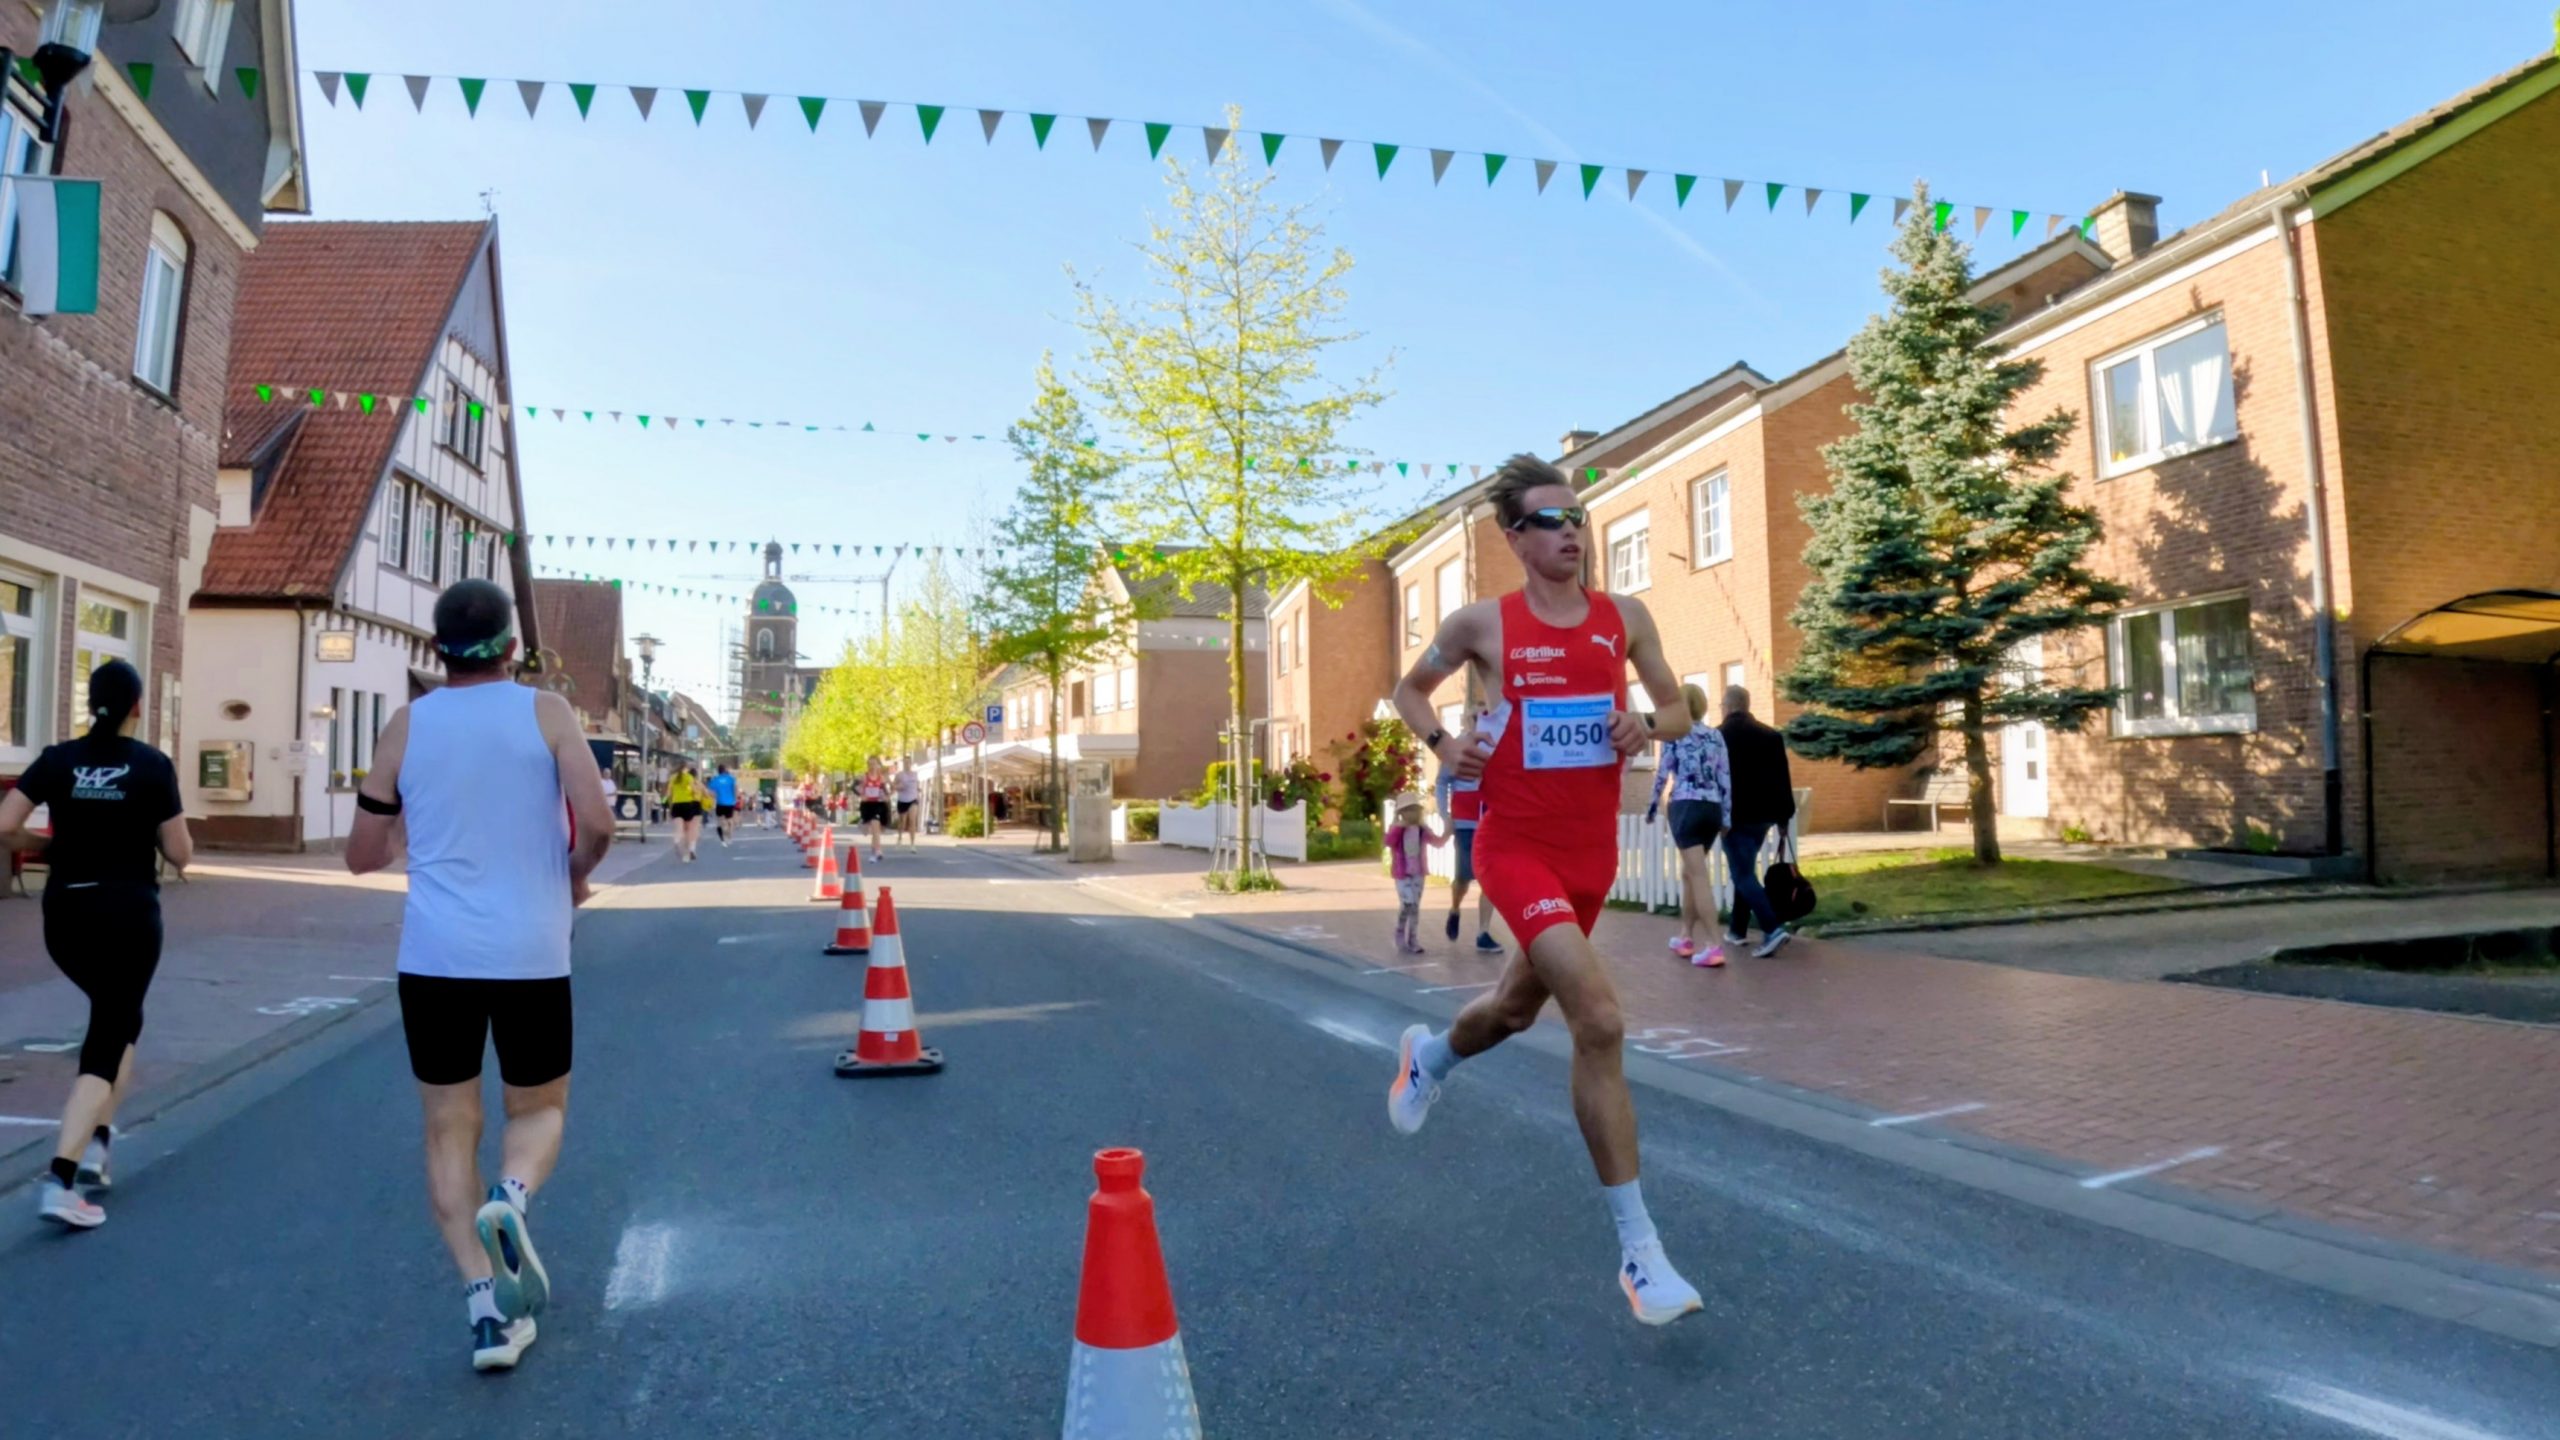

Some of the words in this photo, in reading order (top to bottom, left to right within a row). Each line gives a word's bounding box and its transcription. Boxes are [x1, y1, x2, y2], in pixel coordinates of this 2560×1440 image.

[989, 707, 1001, 721] P
[967, 727, 981, 739] 30
[1541, 723, 1603, 746] 4050
